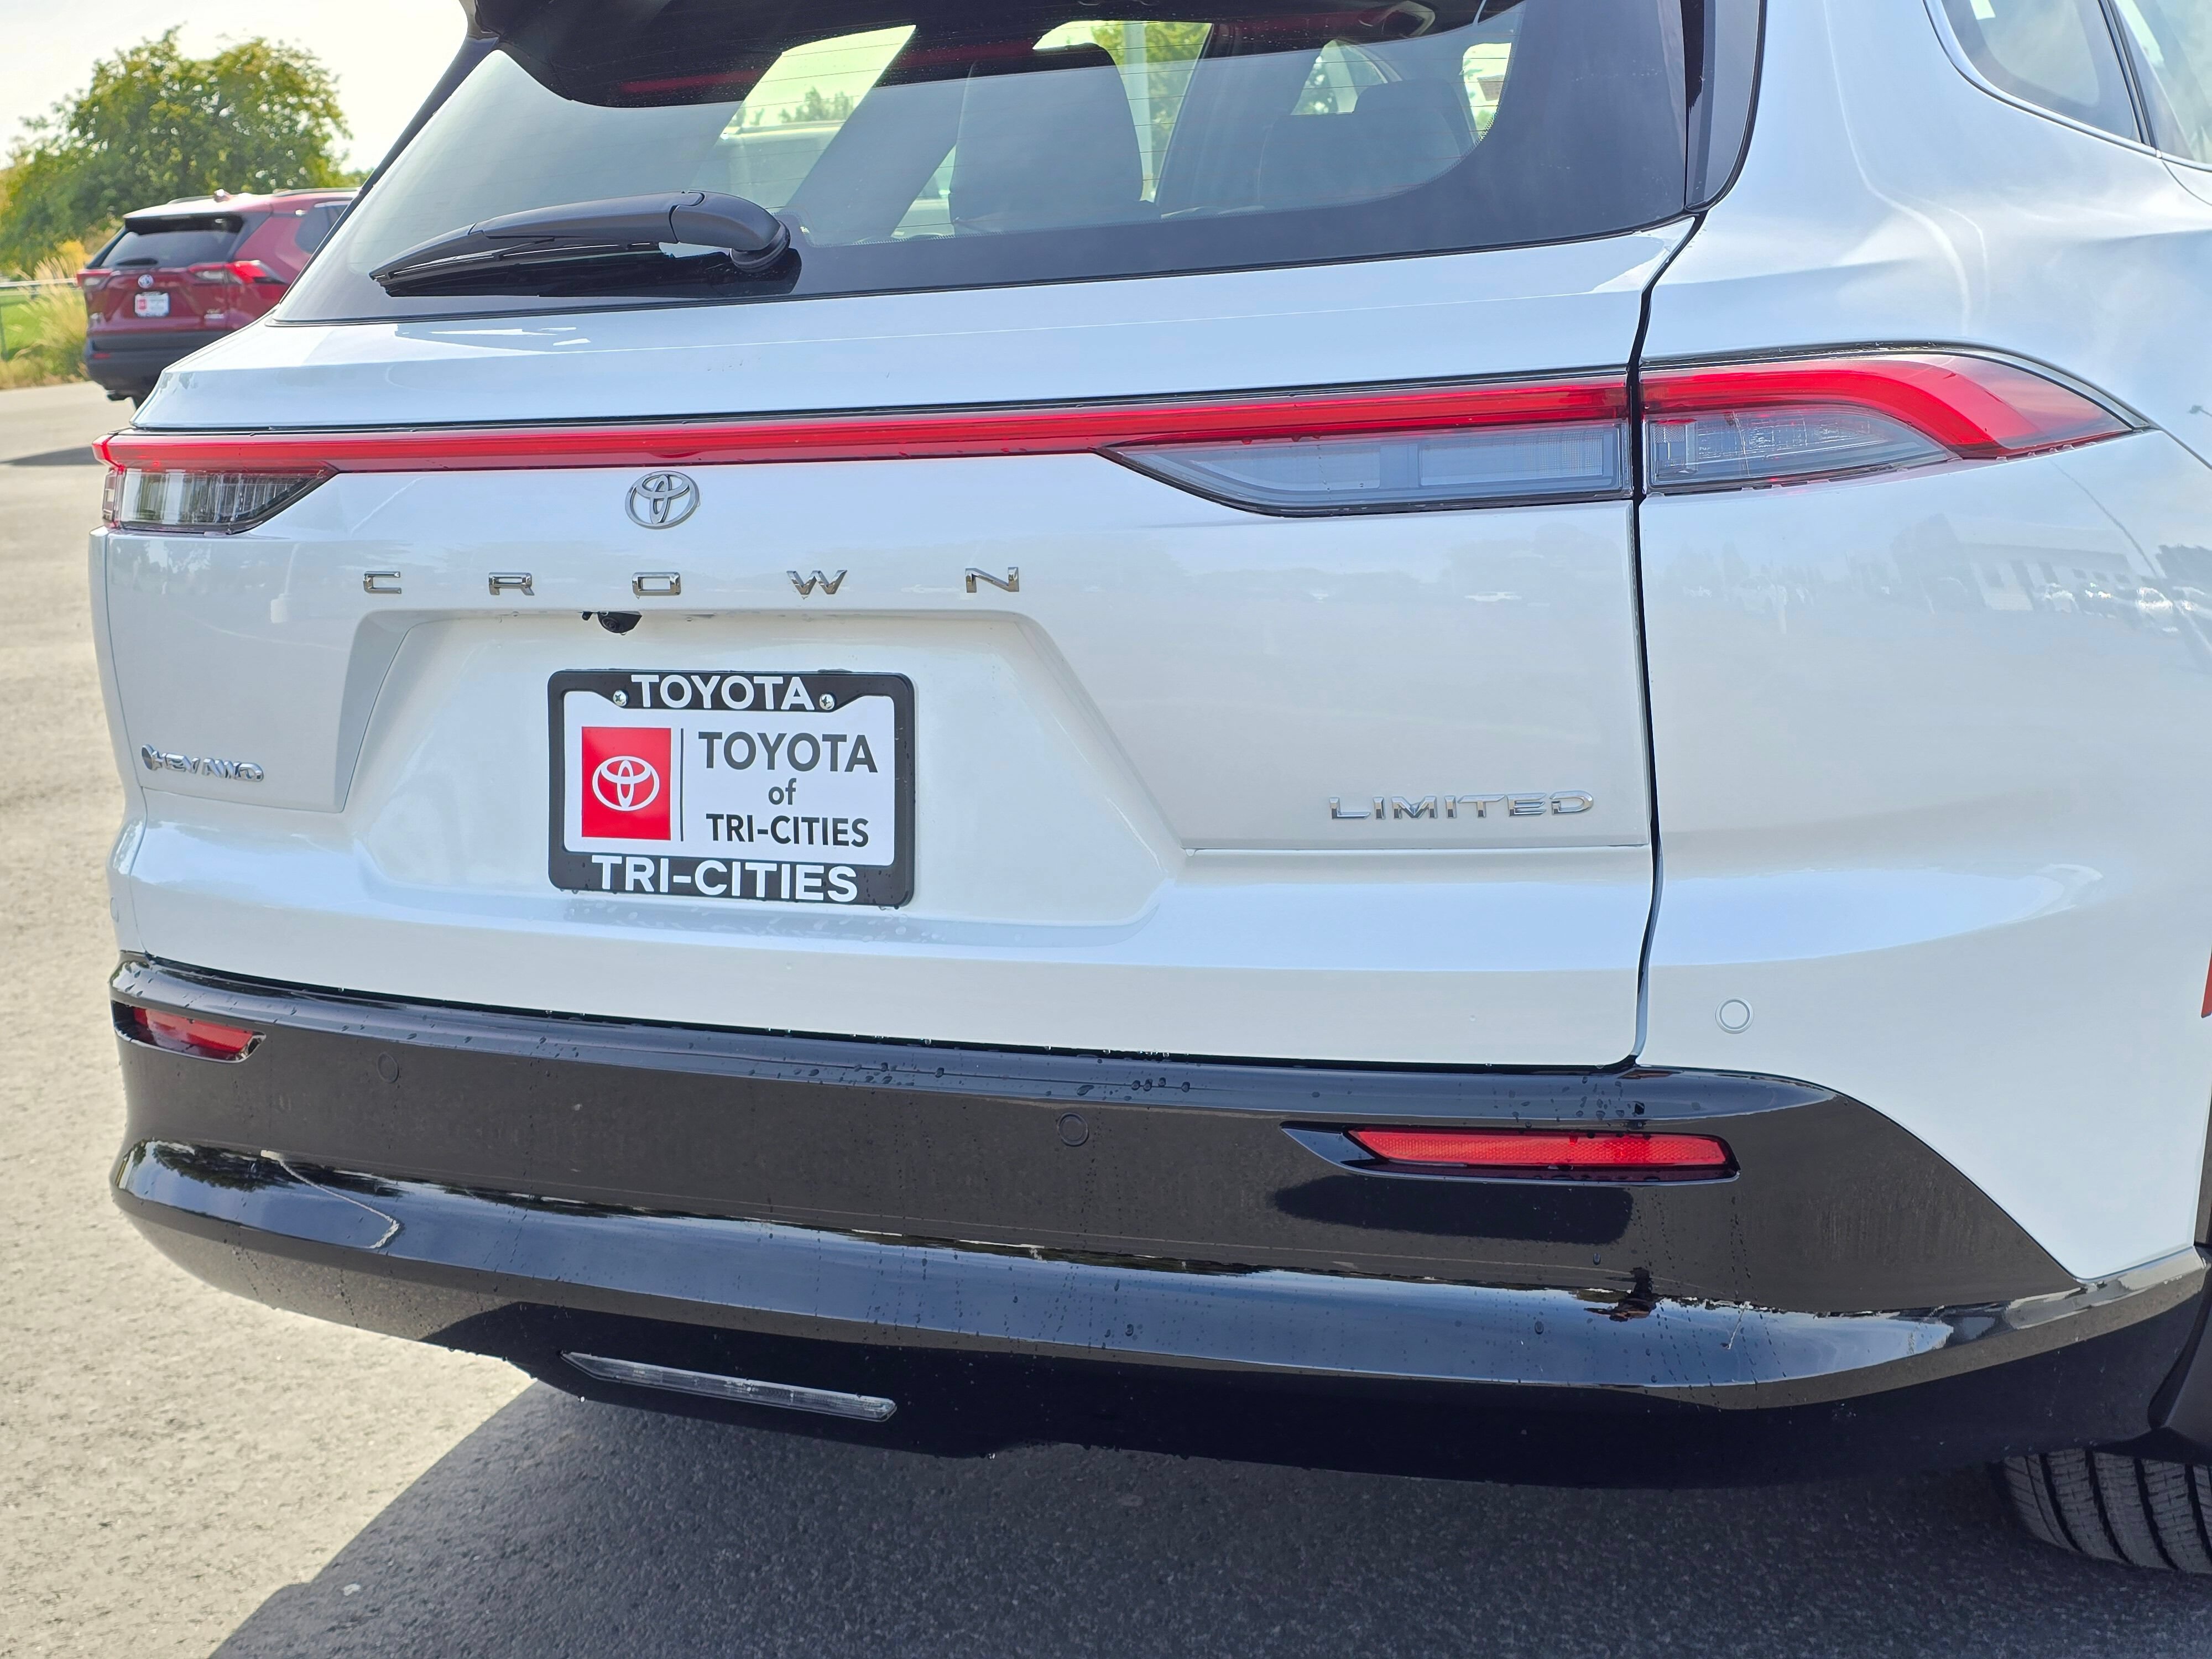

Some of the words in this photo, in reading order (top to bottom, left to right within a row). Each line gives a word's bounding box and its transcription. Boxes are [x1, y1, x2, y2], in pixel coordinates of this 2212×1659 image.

[362, 566, 1020, 597] CROWN
[631, 674, 815, 711] TOYOTA
[698, 731, 878, 773] TOYOTA
[201, 758, 264, 782] AWD
[768, 777, 797, 806] of
[1329, 789, 1594, 820] LIMITED
[706, 813, 869, 848] TRI-CITIES
[591, 854, 858, 902] TRI-CITIES
